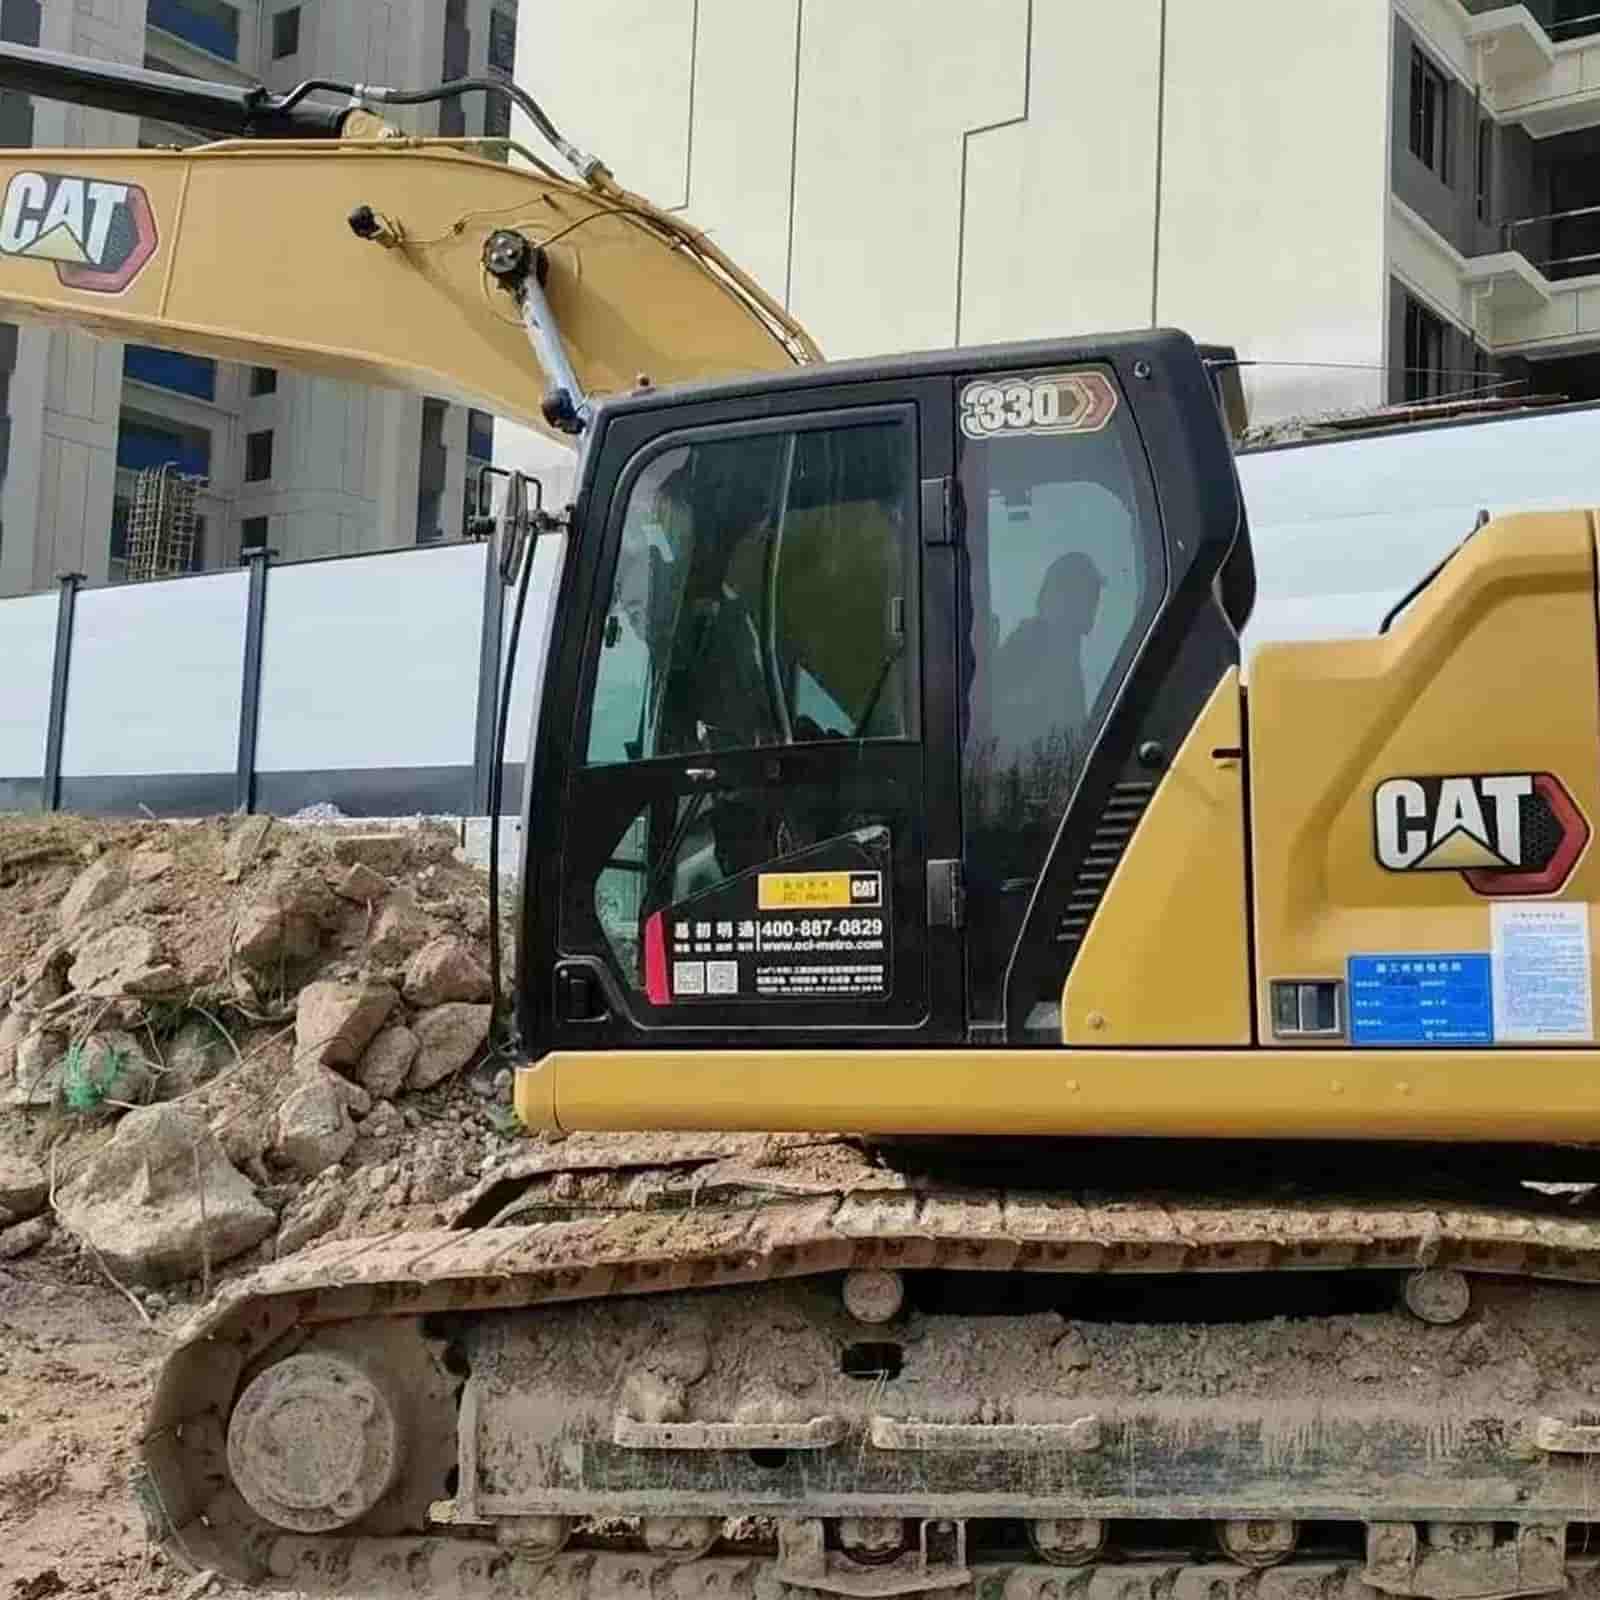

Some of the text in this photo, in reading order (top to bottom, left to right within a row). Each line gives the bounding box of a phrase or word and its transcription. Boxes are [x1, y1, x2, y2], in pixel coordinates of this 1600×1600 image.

[0, 172, 129, 265] CAT
[1375, 775, 1533, 869] CAT
[851, 880, 877, 898] CAT
[761, 919, 883, 937] 400-887-0829
